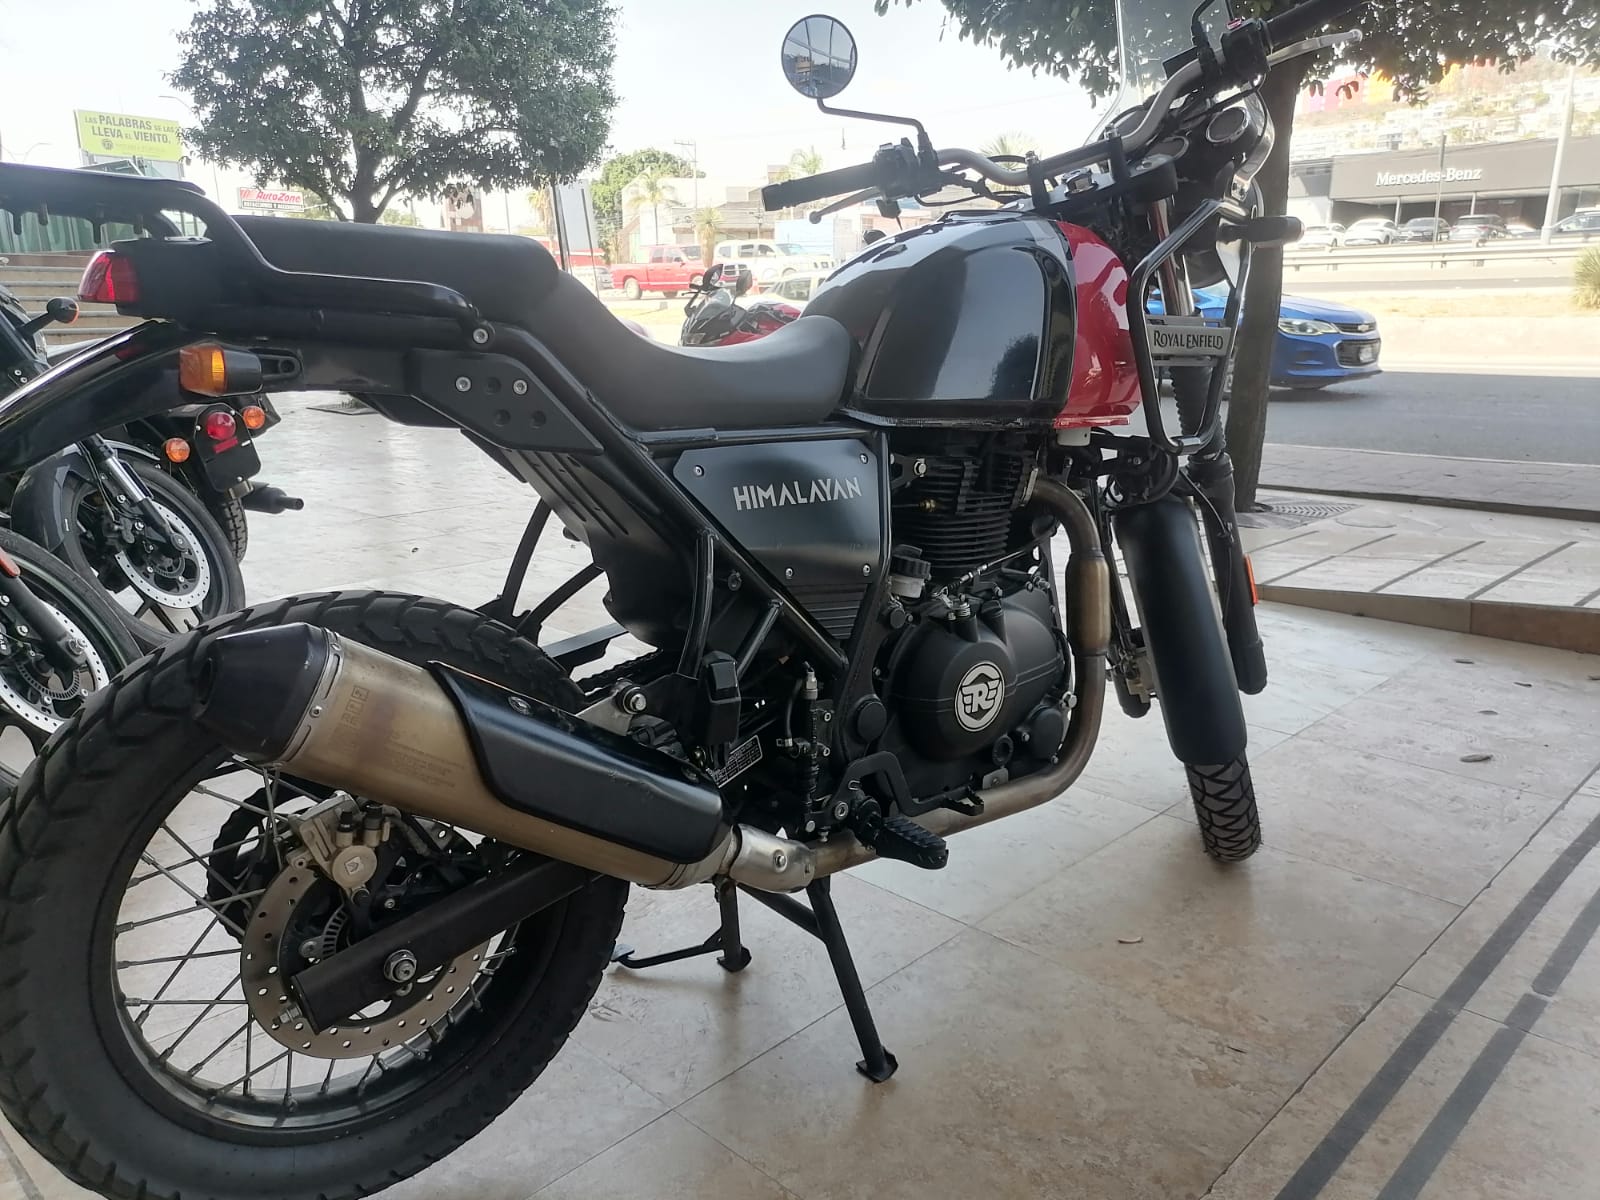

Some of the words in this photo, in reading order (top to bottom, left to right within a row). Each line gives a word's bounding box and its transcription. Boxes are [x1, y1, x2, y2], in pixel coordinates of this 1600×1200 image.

[99, 115, 152, 130] PALABRAS
[92, 126, 123, 139] LLEVA
[1376, 167, 1482, 187] Mercedes-Benz
[256, 191, 301, 203] AutoZone
[1153, 330, 1185, 348] ROYAL
[1186, 334, 1224, 349] ENFIELD
[733, 477, 862, 511] HIMALAYAN
